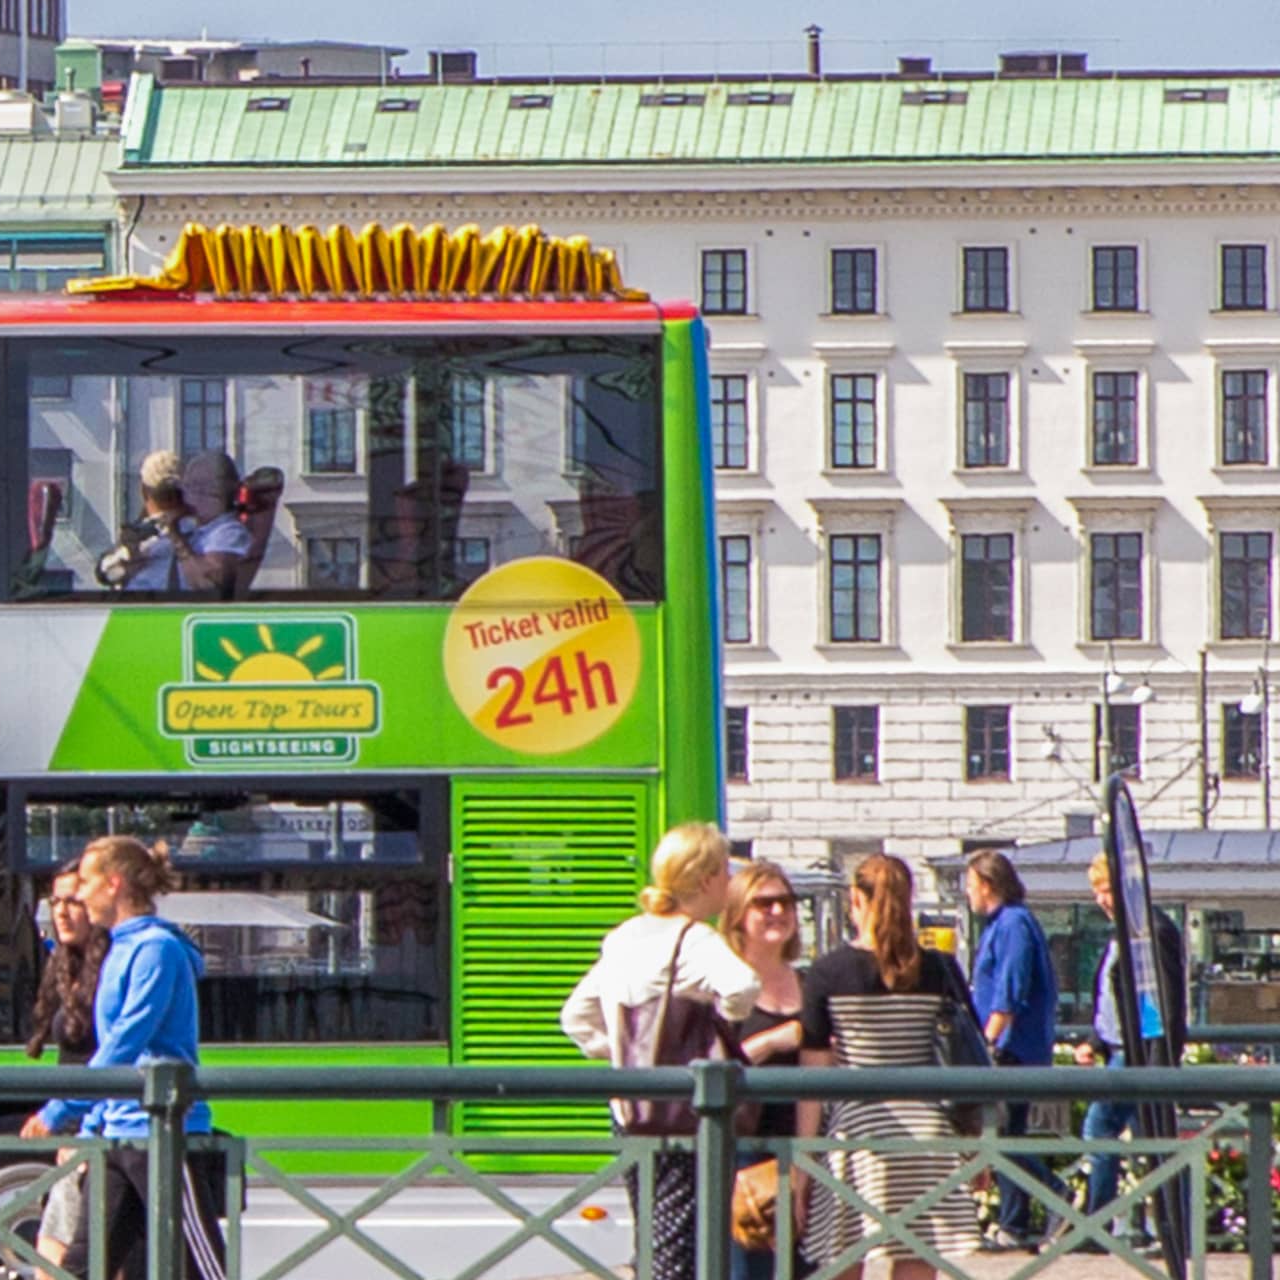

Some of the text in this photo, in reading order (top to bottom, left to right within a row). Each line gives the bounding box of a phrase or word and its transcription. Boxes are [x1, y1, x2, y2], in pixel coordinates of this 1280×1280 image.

[463, 596, 610, 650] Ticket valid
[486, 650, 618, 730] 24h
[174, 698, 363, 729] Open Top Tours
[208, 739, 336, 755] SIGHTSEEING
